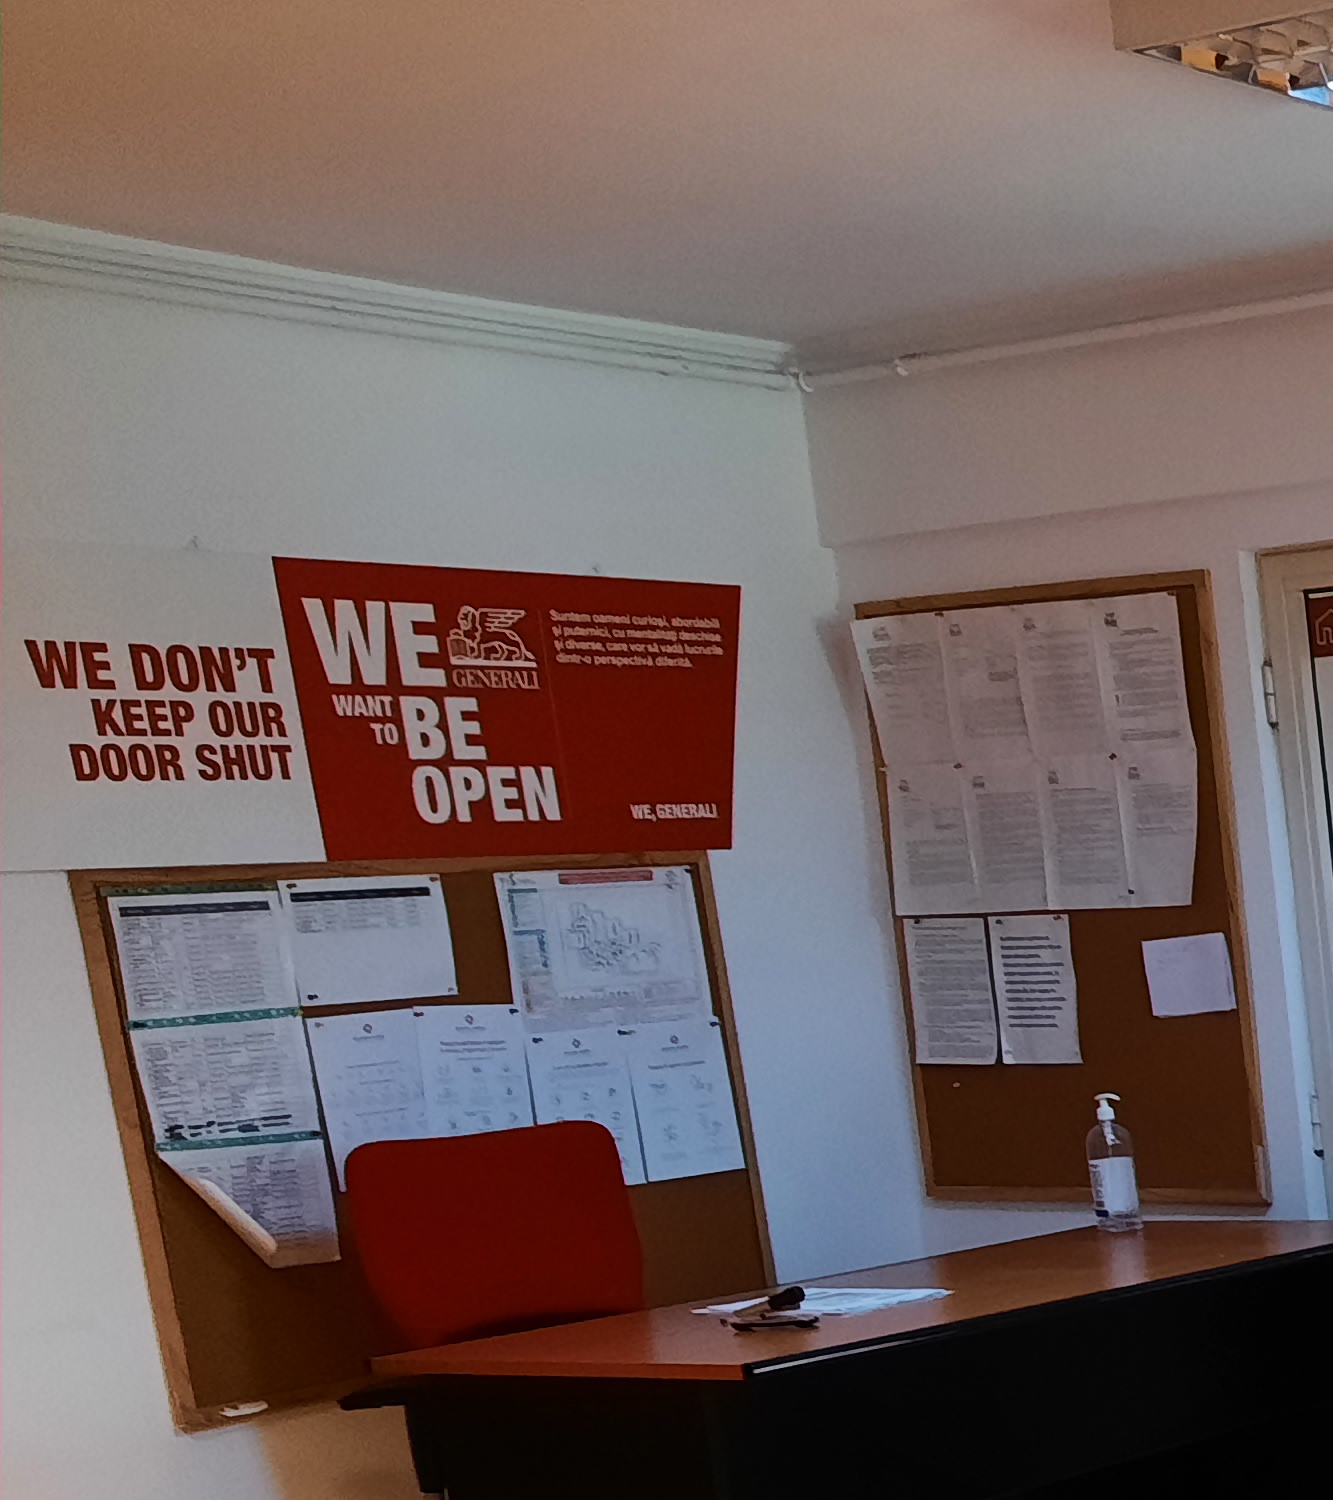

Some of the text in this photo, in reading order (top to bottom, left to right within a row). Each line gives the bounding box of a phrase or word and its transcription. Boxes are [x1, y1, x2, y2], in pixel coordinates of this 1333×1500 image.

[300, 596, 448, 688] WE
[23, 639, 276, 694] WE DON'T
[451, 669, 541, 690] GENERALI
[90, 698, 289, 738] KEEP OUR
[331, 693, 394, 718] WANT
[369, 722, 400, 746] TO
[398, 695, 489, 761] BE
[68, 743, 293, 782] DOOR SHUT
[411, 765, 563, 825] OPEN
[629, 803, 720, 823] WE, GENERALI
